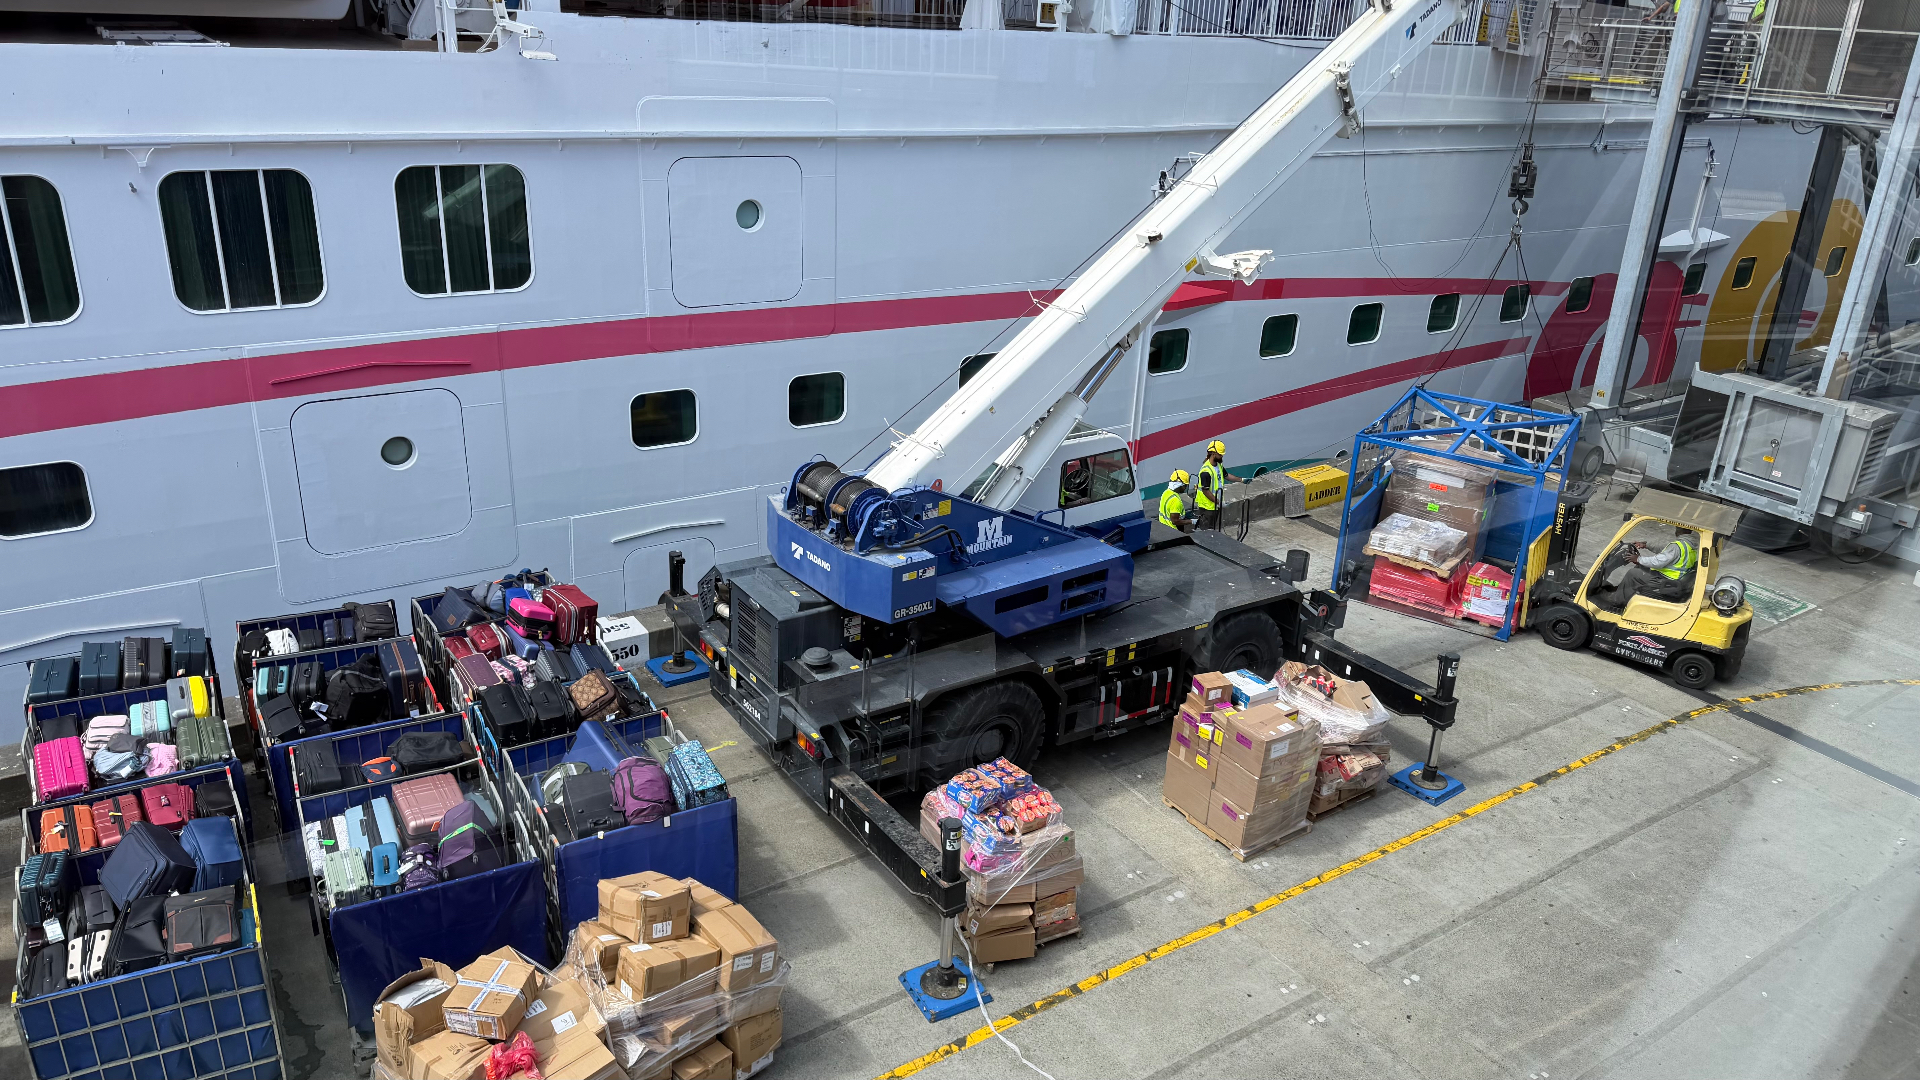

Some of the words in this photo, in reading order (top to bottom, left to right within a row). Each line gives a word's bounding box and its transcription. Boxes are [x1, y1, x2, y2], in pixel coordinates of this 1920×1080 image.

[1419, 0, 1442, 23] TADANO
[1308, 485, 1341, 502] LADDER
[1554, 502, 1566, 535] HYSTER
[966, 534, 1013, 555] MOUNTAIN
[805, 550, 831, 572] TADANO
[894, 601, 933, 619] GR-350XL
[610, 643, 640, 662] 550
